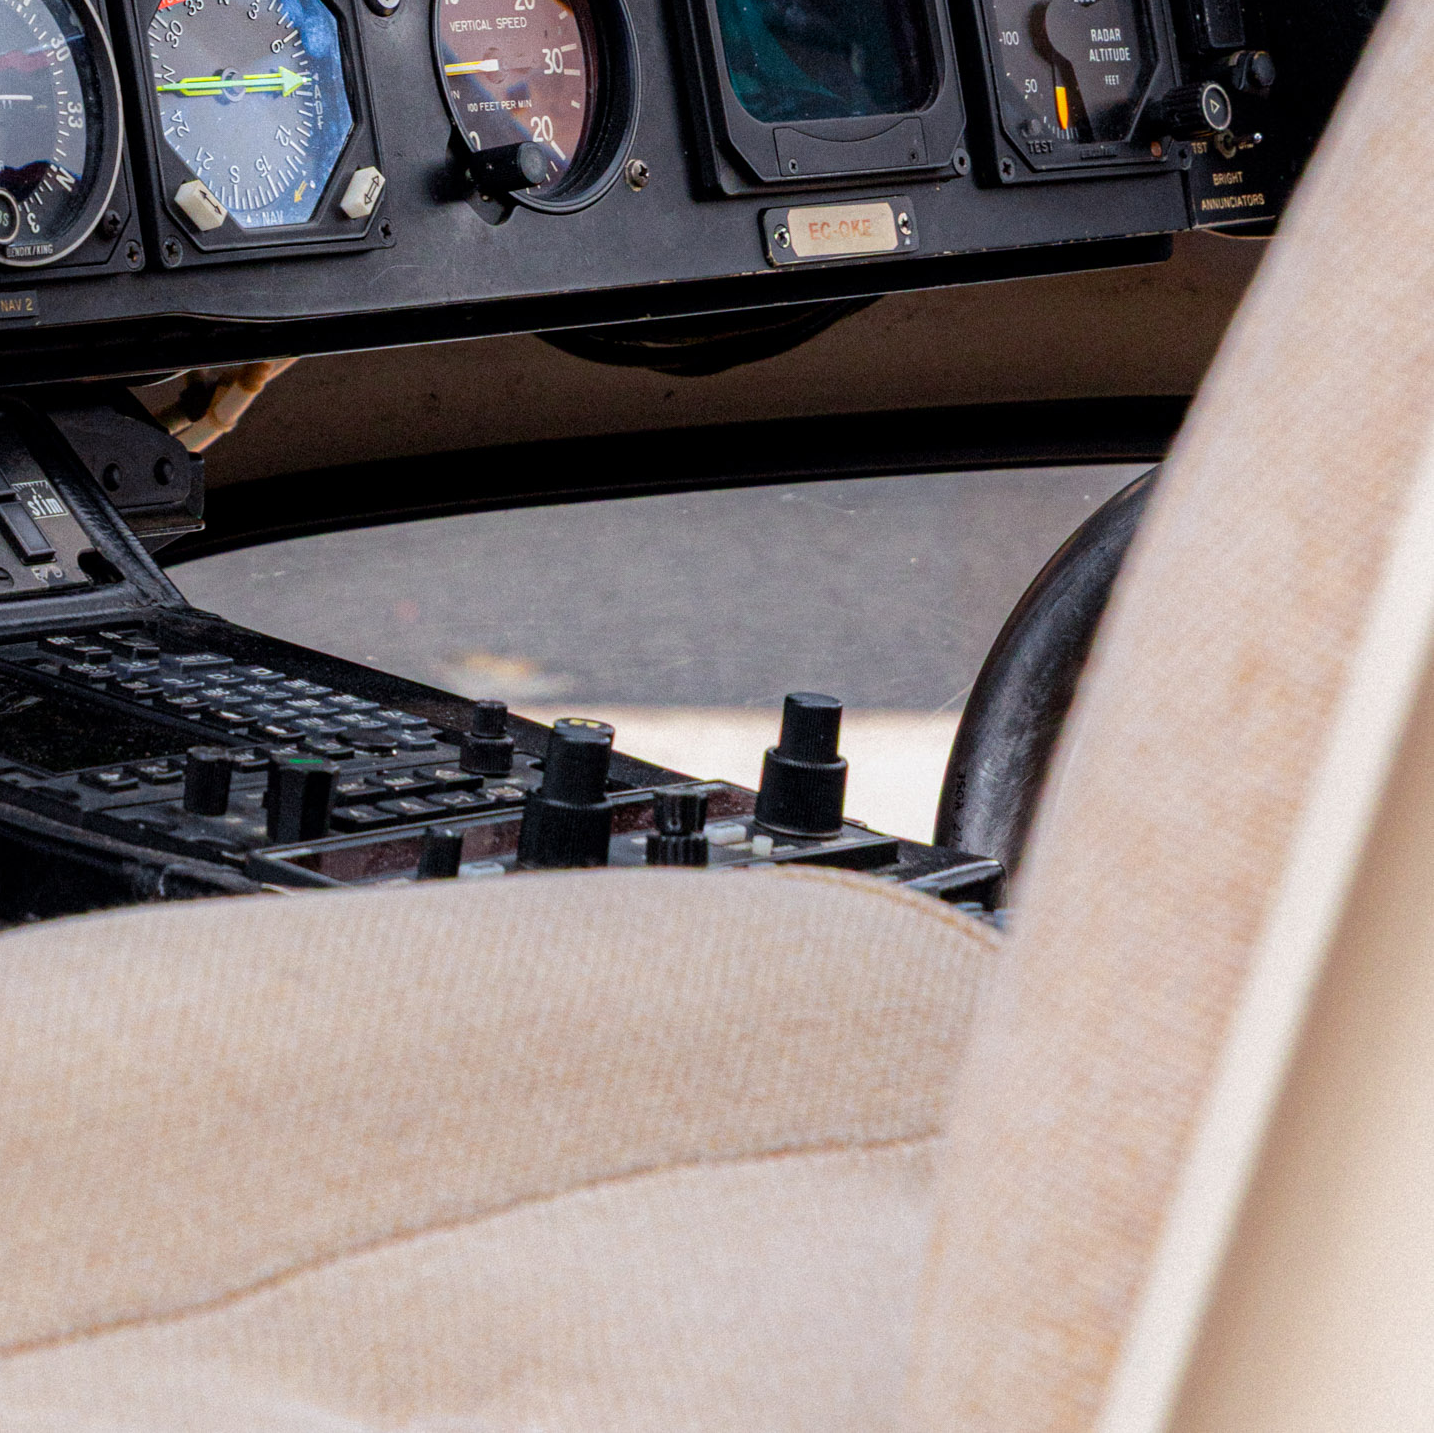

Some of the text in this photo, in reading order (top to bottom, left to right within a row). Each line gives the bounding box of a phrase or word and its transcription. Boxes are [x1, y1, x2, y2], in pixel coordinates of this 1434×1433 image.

[449, 15, 527, 33] VERTICAL SPEED
[1090, 28, 1122, 43] RADAR
[542, 48, 564, 75] 30
[1089, 47, 1131, 63] ALTITUDE
[1105, 74, 1120, 85] FEET
[1213, 171, 1244, 186] BRIGHT
[1201, 193, 1265, 212] ANNUNCIATORS
[6, 243, 54, 258] BENDIX/KING
[0, 297, 33, 313] NAV 2
[27, 493, 64, 517] sfim
